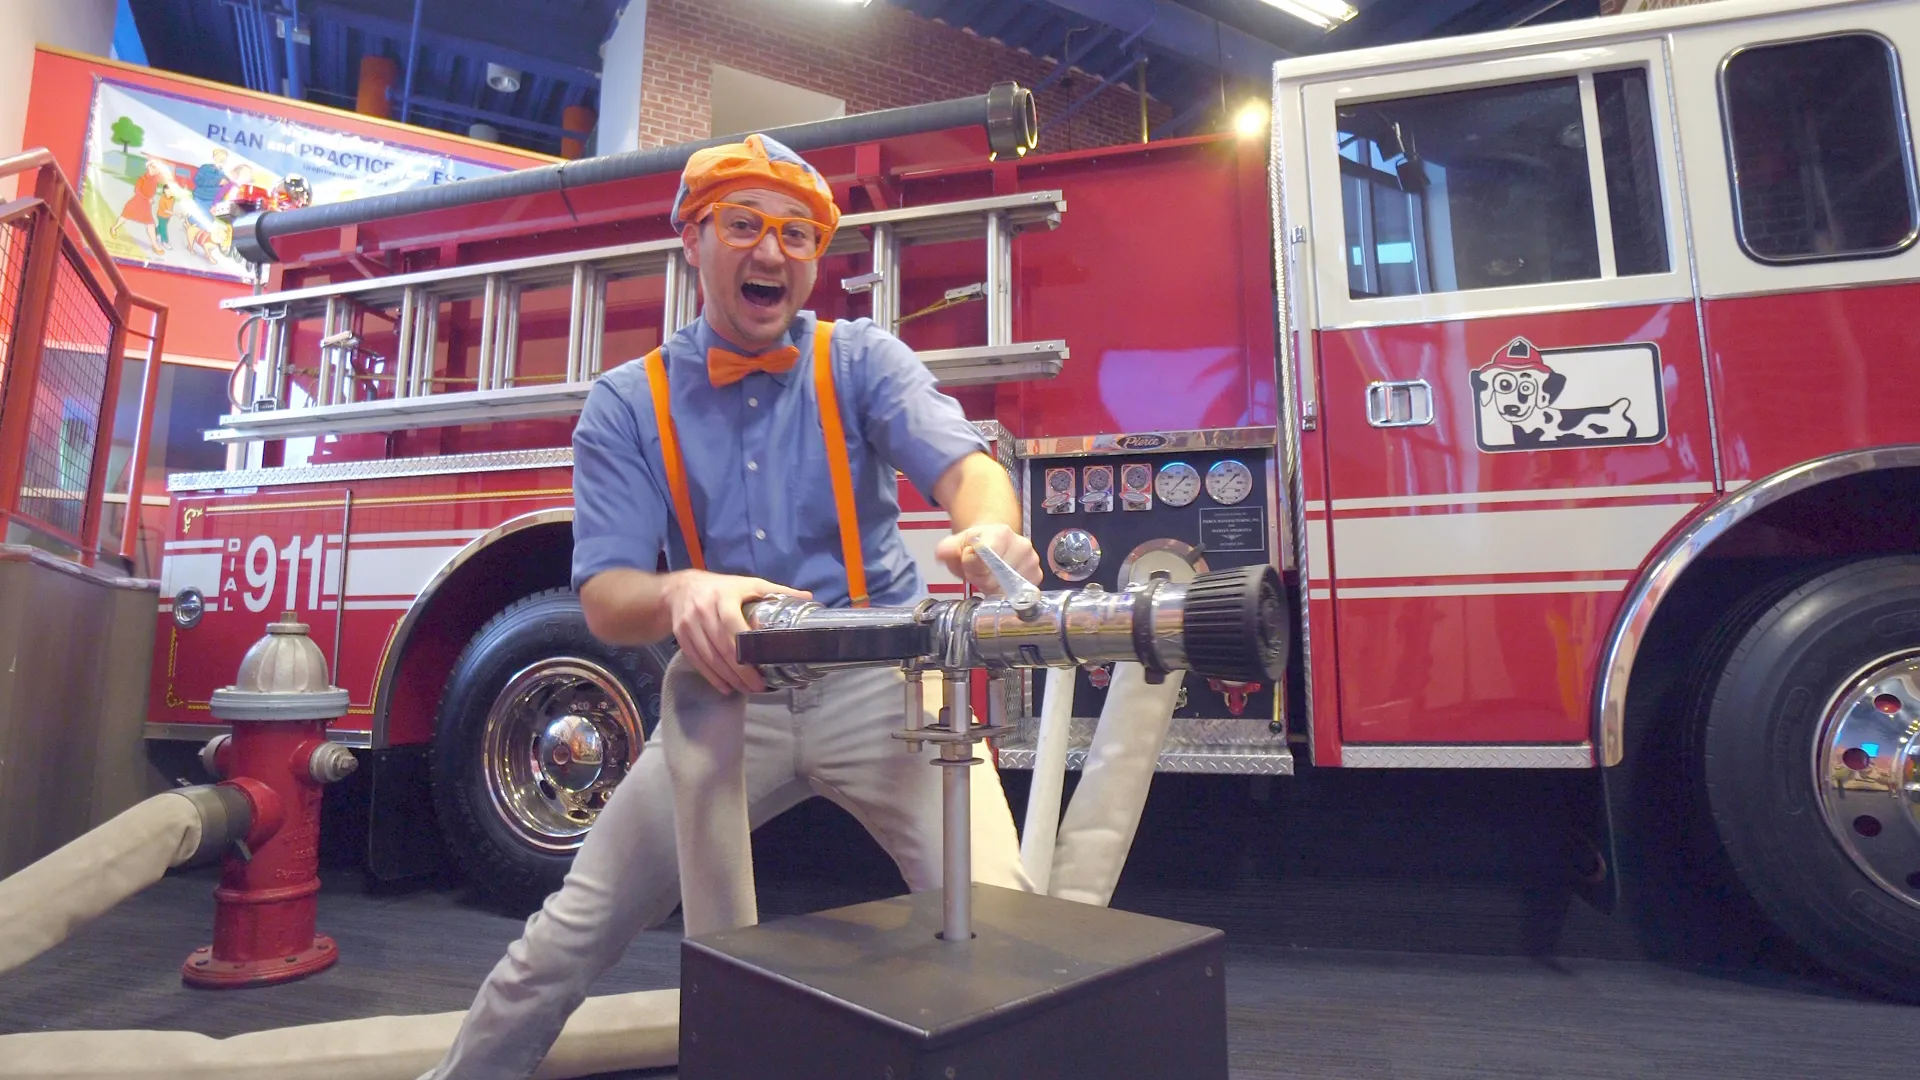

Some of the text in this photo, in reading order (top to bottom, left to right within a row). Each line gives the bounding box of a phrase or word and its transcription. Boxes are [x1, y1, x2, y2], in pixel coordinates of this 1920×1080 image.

[207, 123, 264, 151] PLAN
[1123, 436, 1160, 449] Pierce
[223, 534, 324, 613] DIAL 911
